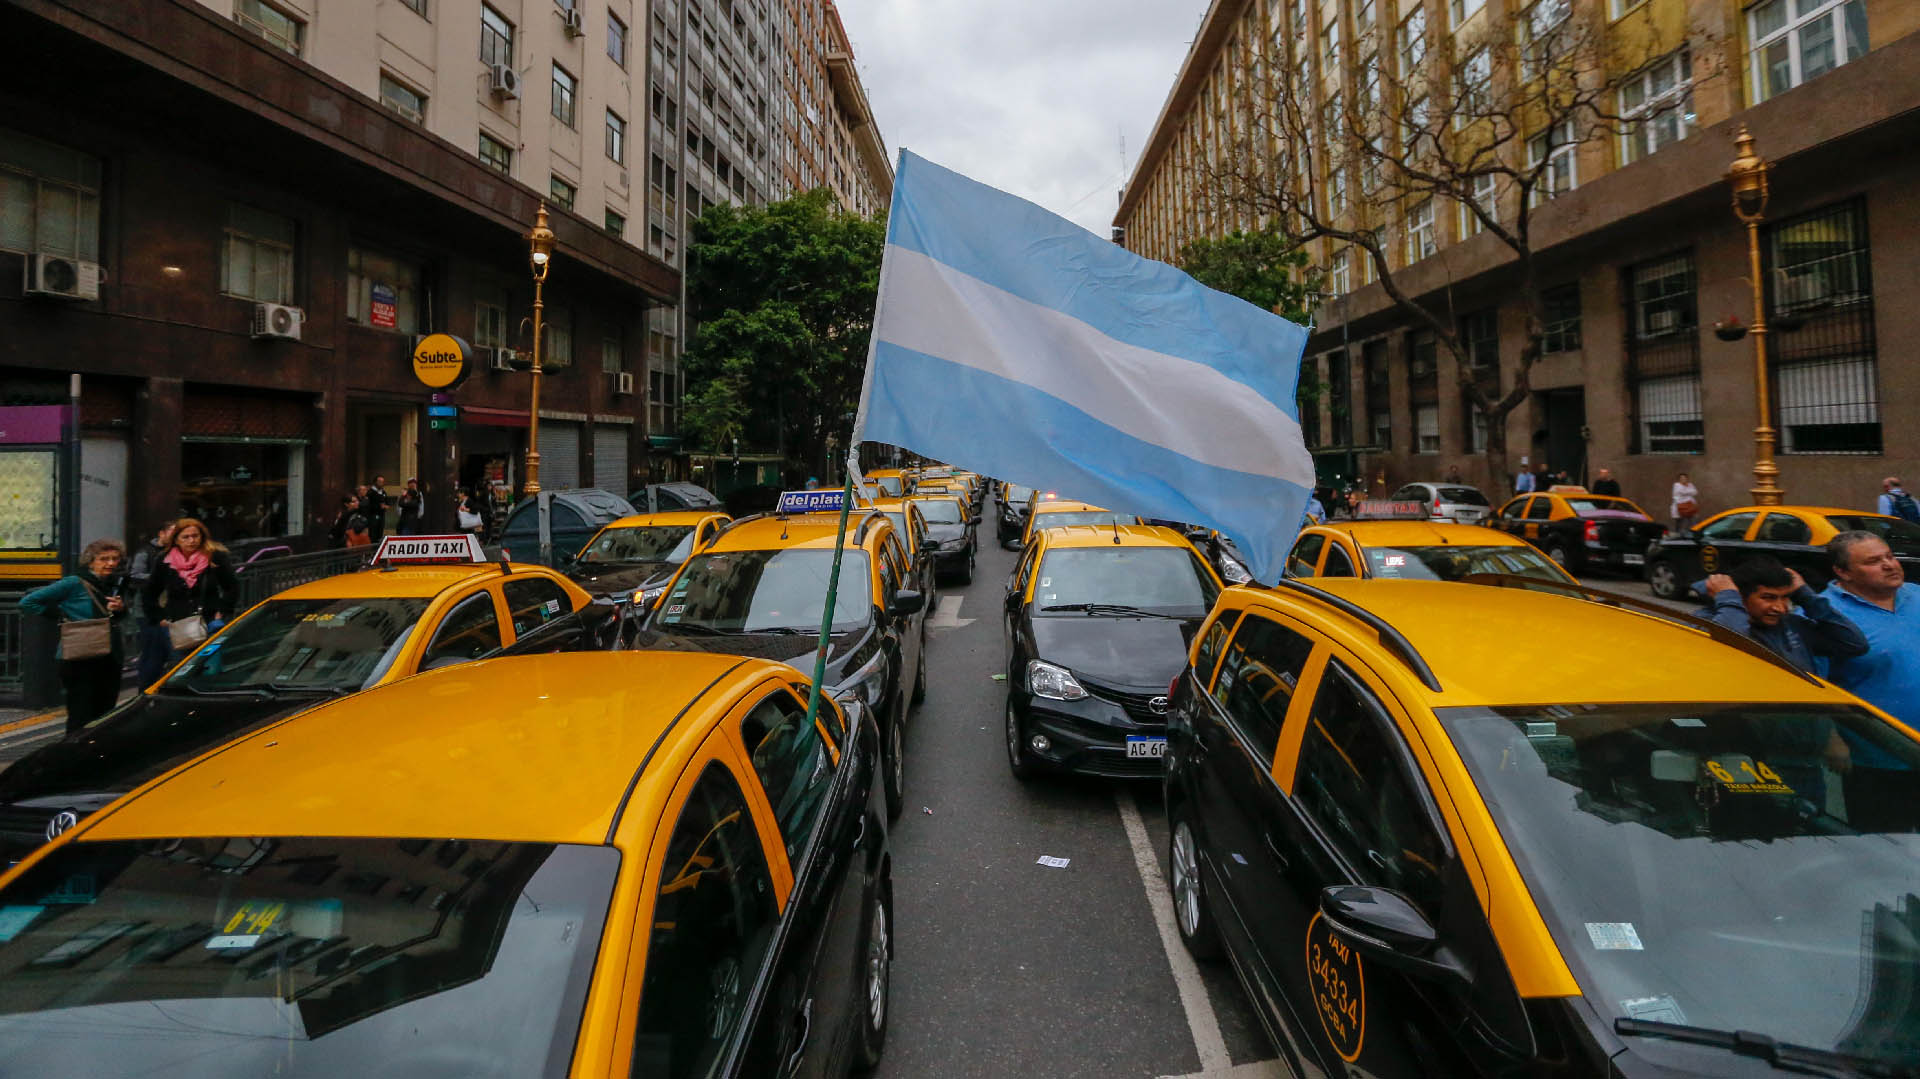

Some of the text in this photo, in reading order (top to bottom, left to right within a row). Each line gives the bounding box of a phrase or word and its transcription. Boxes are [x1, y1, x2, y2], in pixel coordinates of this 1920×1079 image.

[418, 351, 460, 364] Subte
[432, 394, 438, 403] E
[431, 420, 439, 429] D
[785, 494, 809, 505] del
[388, 542, 464, 555] RADIO TAXI
[1130, 743, 1147, 756] AC
[1706, 760, 1783, 784] 6 14
[1312, 943, 1358, 1031] 34334
[1320, 992, 1347, 1044] GCBA
